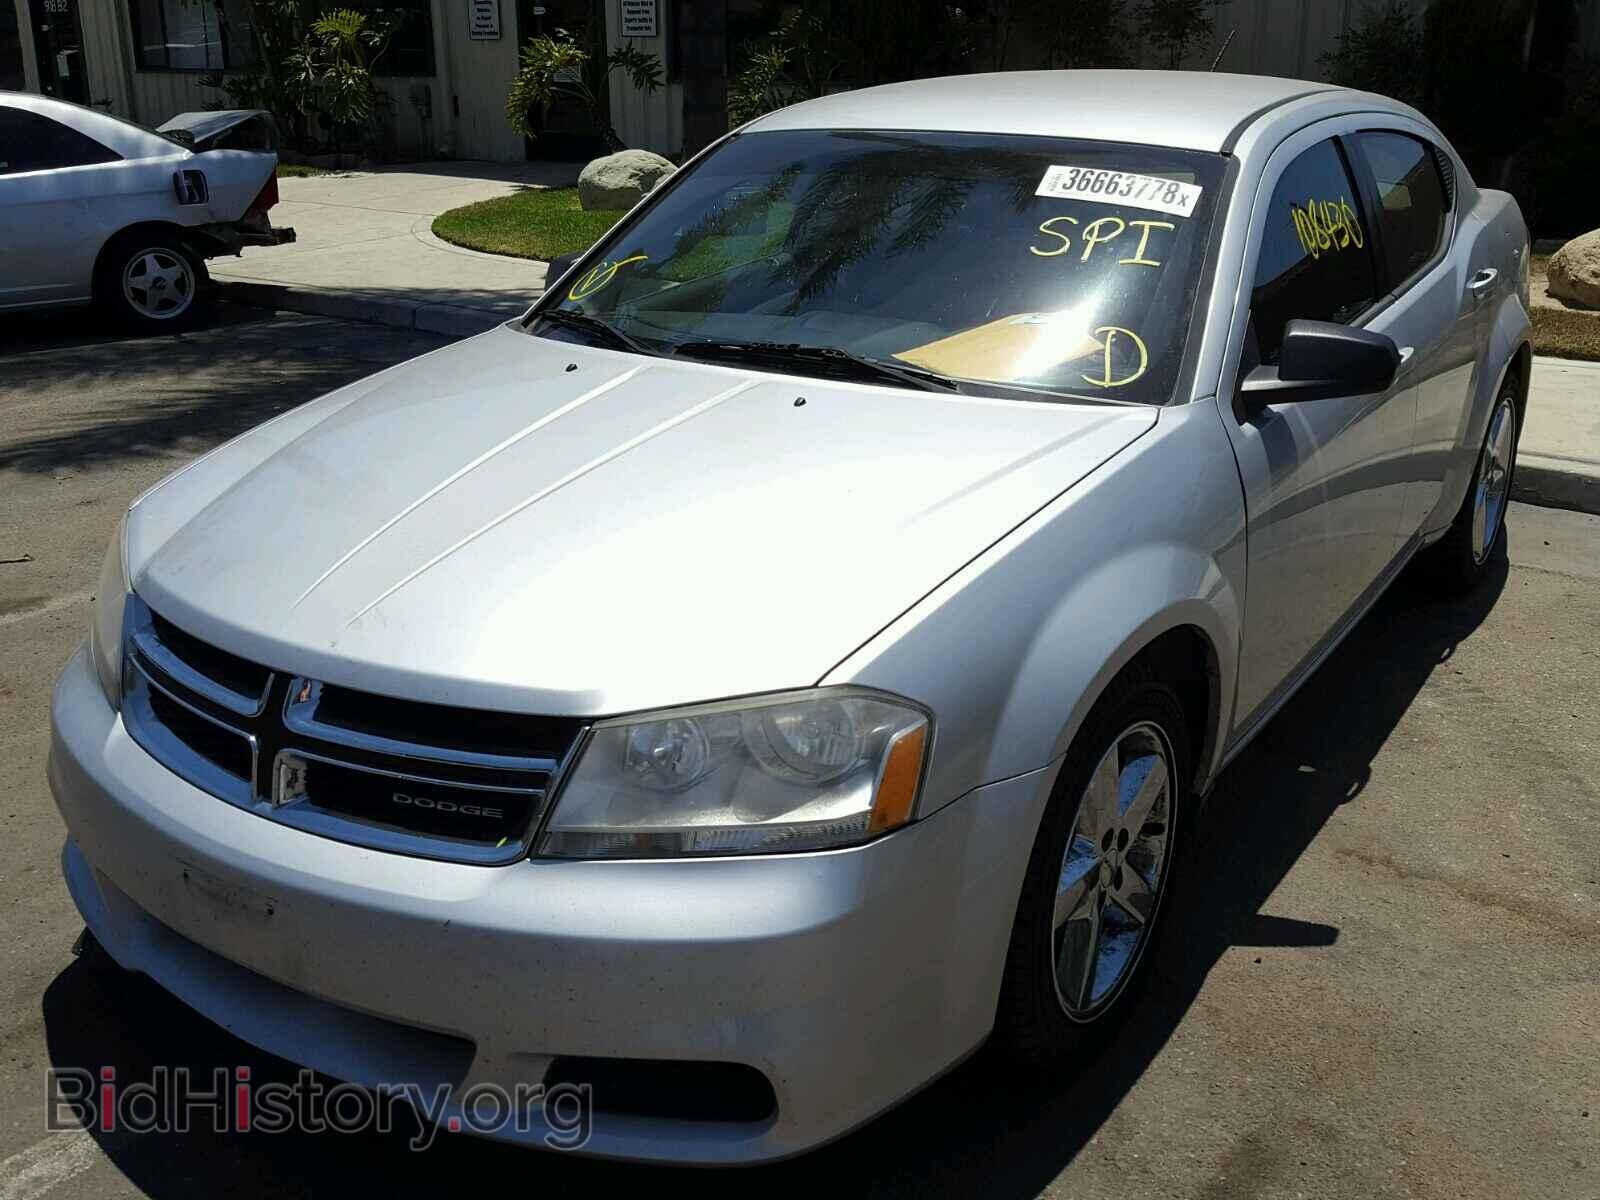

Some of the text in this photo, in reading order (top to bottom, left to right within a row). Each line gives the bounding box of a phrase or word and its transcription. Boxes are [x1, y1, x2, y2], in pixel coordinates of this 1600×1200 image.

[1030, 217, 1175, 267] SPI
[1081, 326, 1148, 388] D
[391, 791, 504, 820] DODGE
